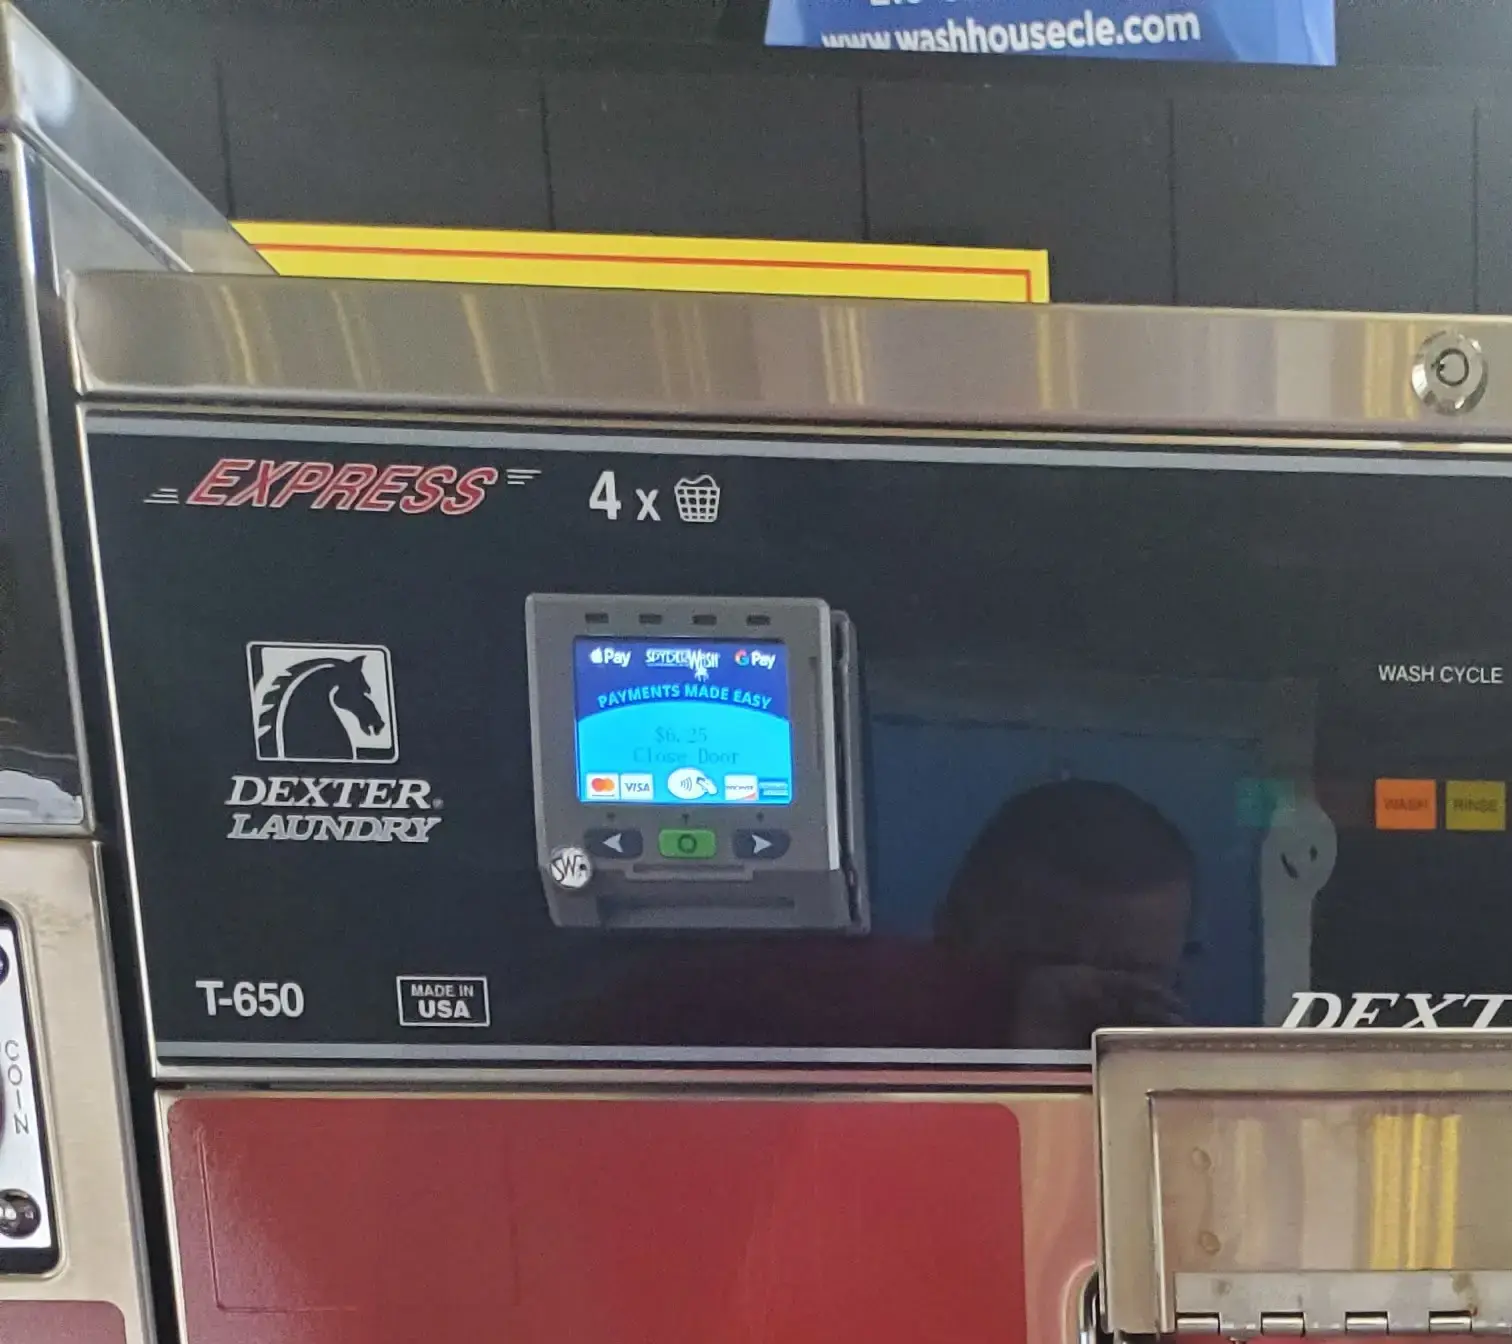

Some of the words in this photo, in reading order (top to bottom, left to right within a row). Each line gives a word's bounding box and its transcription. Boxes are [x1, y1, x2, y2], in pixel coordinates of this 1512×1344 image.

[821, 9, 1201, 54] wwwwashhousecle.com
[187, 458, 498, 514] EXPRESS
[589, 470, 622, 520] 4
[605, 648, 631, 667] Pay
[751, 650, 776, 669] Pay
[1378, 664, 1435, 683] WASH
[1440, 666, 1504, 684] CYCLE
[597, 684, 681, 708] PAYMENTS
[684, 683, 729, 700] MADE
[733, 690, 772, 709] EASY
[633, 747, 687, 764] Close
[698, 748, 740, 764] Door
[225, 776, 432, 809] DEXTER
[624, 782, 650, 792] VISA
[226, 814, 441, 842] LAUNDRY
[195, 980, 304, 1018] T-650
[411, 983, 454, 997] MADE
[457, 984, 474, 998] IN
[418, 1000, 471, 1019] USA
[4, 1040, 29, 1135] COIN
